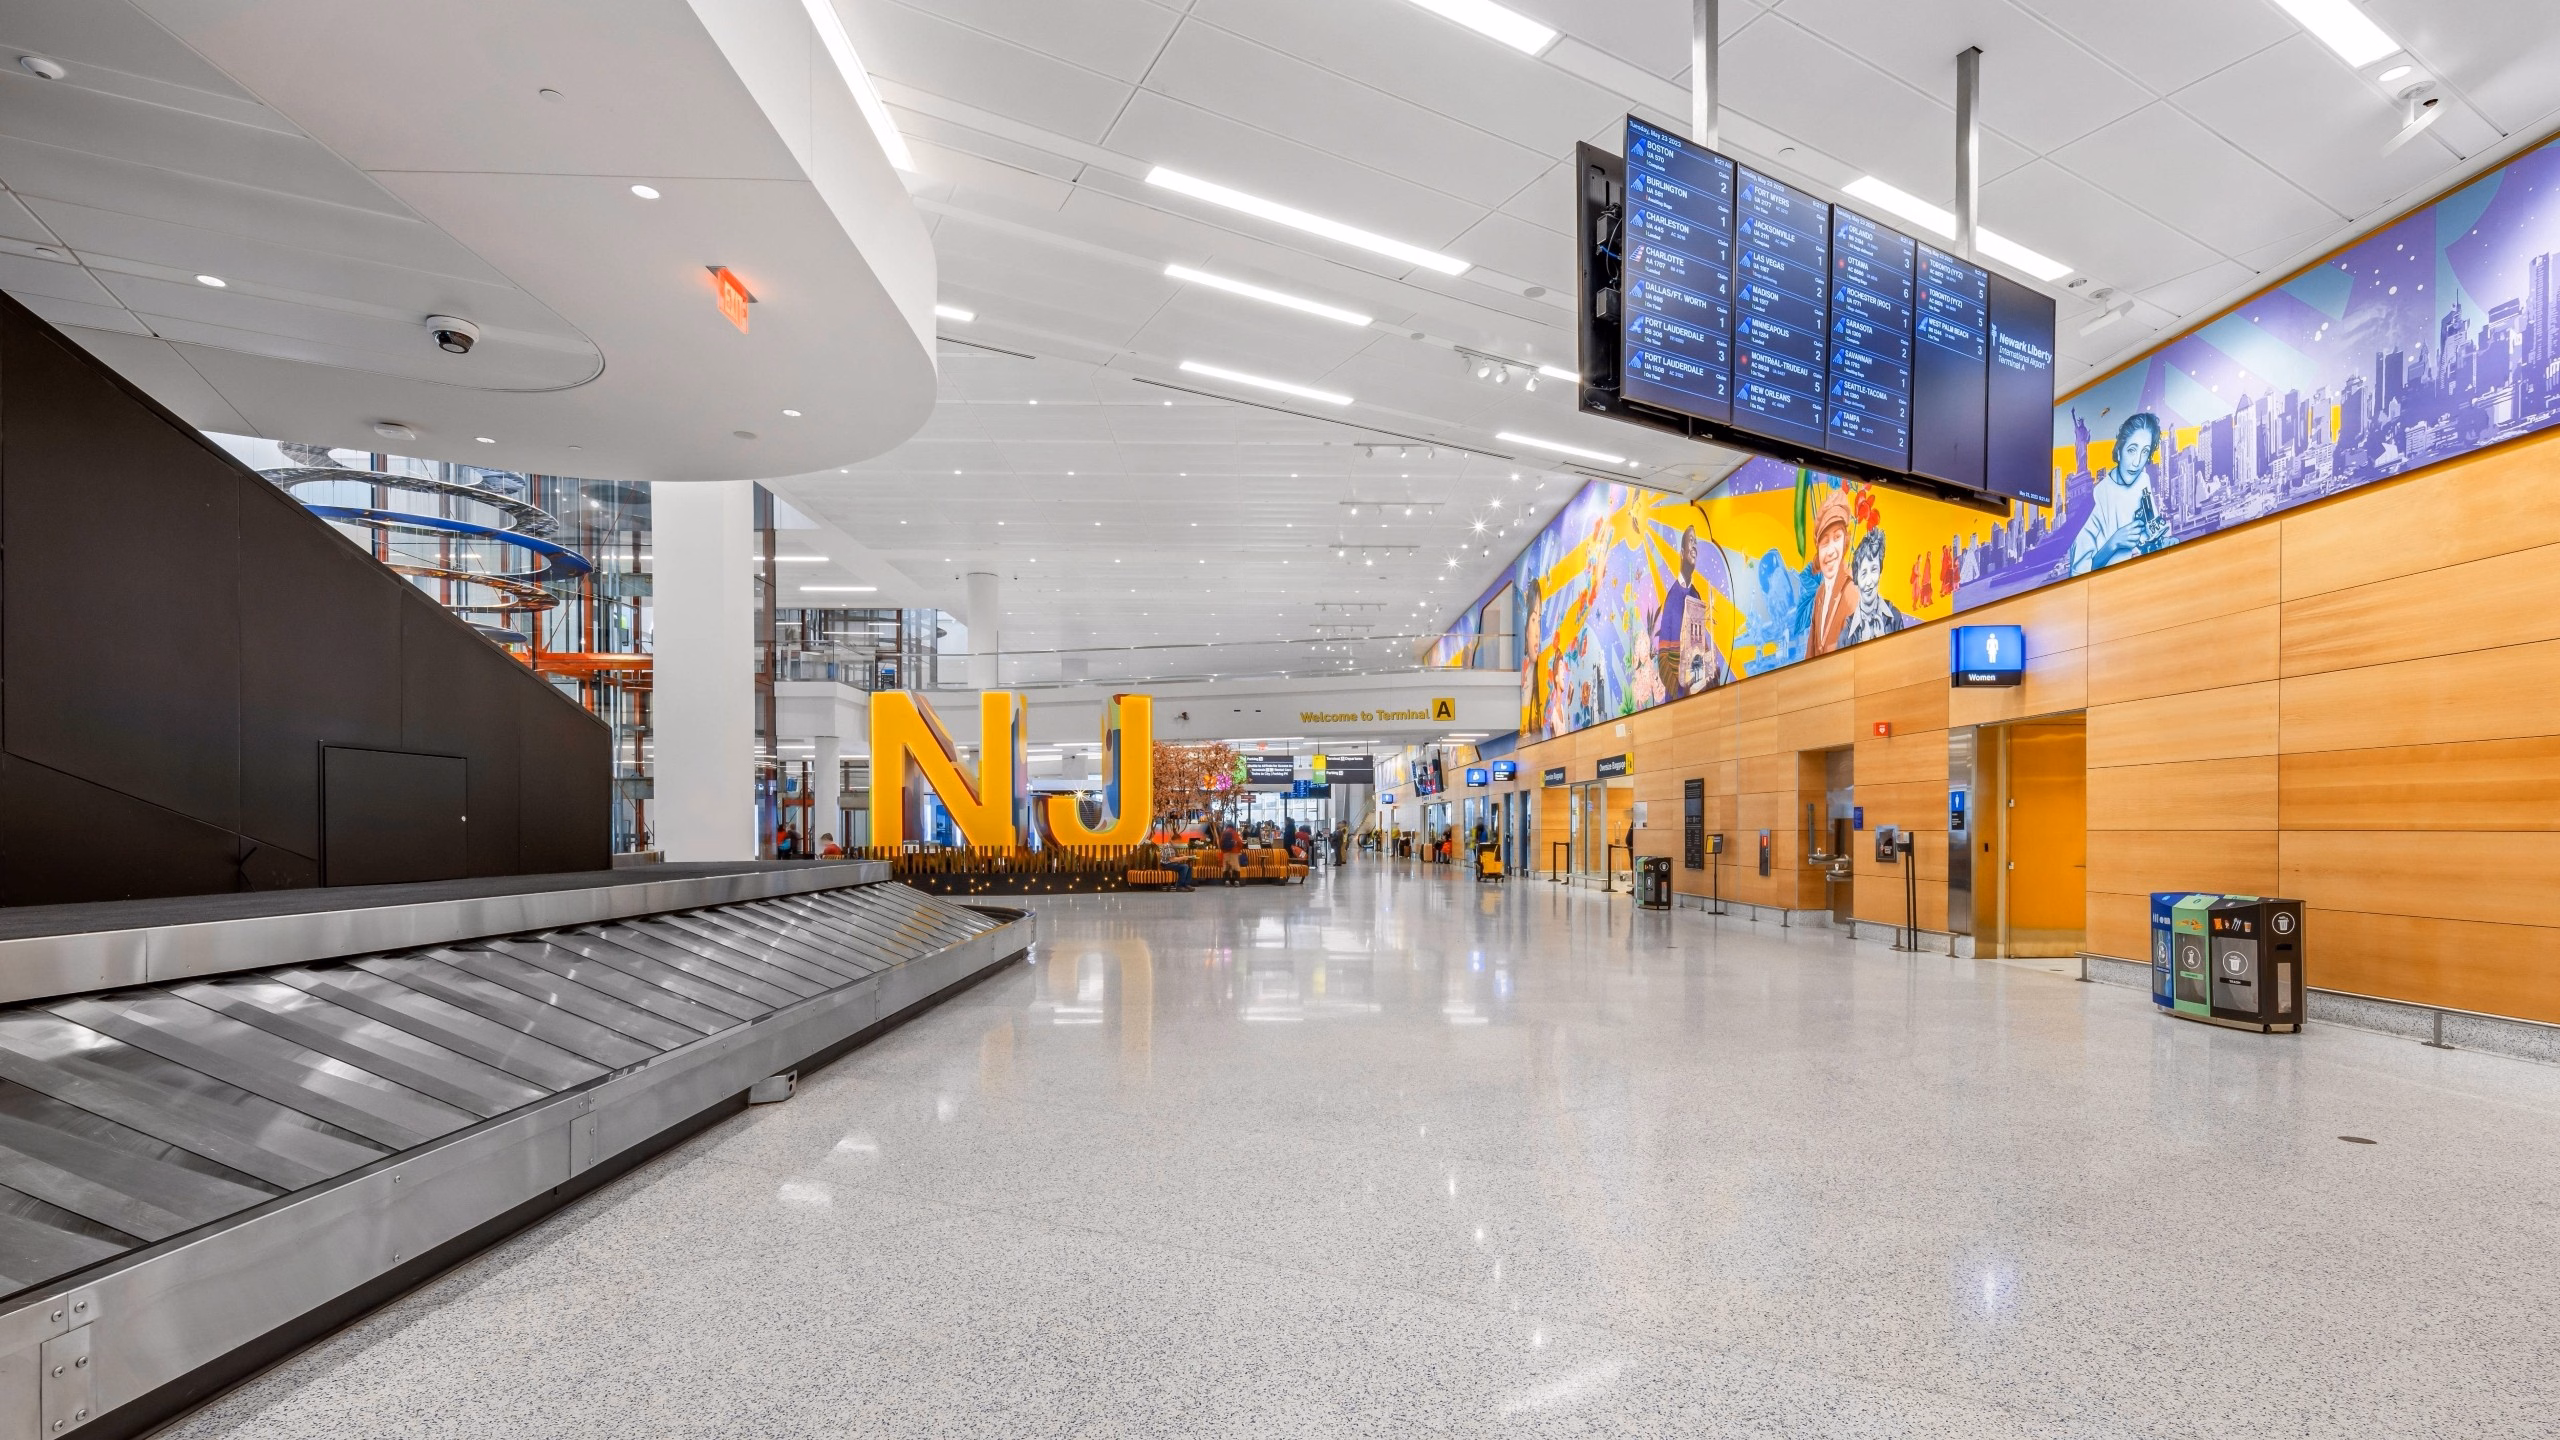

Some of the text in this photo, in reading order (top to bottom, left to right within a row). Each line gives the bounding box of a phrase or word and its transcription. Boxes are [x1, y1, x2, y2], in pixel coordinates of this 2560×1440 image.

[1629, 121, 1649, 135] Tuesday,
[1651, 130, 1660, 139] May
[1669, 138, 1681, 147] 2023
[1647, 141, 1674, 158] BOSTON
[1655, 154, 1664, 163] 570
[1647, 176, 1687, 198] BURLINGTON
[1721, 183, 1727, 193] 2
[1758, 176, 1766, 185] May
[1774, 183, 1784, 192] 2023
[1755, 186, 1789, 208] FORT MYERS
[1646, 212, 1689, 234] CHARLESTON
[1646, 222, 1664, 233] UA 445
[1754, 220, 1795, 242] JACKSONVILLE
[1754, 229, 1760, 237] UA
[1848, 225, 1873, 240] ORLANDO
[1645, 247, 1684, 266] CHARLOTTE
[1646, 258, 1665, 269] AA 1707
[1753, 253, 1784, 270] LAS VEGAS
[1848, 257, 1868, 270] OTTAWA
[1904, 258, 1909, 268] 3
[1930, 259, 1950, 273] TORONTO
[1645, 282, 1706, 308] DALLAS/FT. WORTH
[1720, 284, 1725, 294] 4
[1753, 286, 1778, 301] MADISON
[1817, 287, 1822, 298] 2
[1847, 288, 1876, 305] ROCHESTER
[1929, 288, 1950, 303] TORONTO
[1645, 317, 1662, 328] FORT
[1663, 323, 1704, 342] LAUDERDALE
[1752, 319, 1789, 337] MINNEAPOLIS
[1846, 319, 1872, 334] SARASOTA
[1929, 318, 1941, 327] WEST
[1942, 323, 1953, 333] PALM
[1954, 327, 1969, 339] BEACH
[1978, 318, 1983, 327] 5
[1719, 351, 1725, 361] 3
[1816, 351, 1821, 360] 2
[2000, 333, 2052, 364] Newark Liberty
[1645, 352, 1662, 363] FORT
[1663, 358, 1703, 376] LAUDERDALE
[1845, 350, 1872, 365] SAVANNAH
[1998, 355, 2020, 370] Terminal
[1999, 346, 2045, 369] International Airport
[1652, 365, 1664, 373] 1508
[1718, 384, 1724, 395] 2
[1751, 384, 1790, 403] NEW ORLEANS
[1815, 382, 1820, 392] 5
[1844, 381, 1887, 400] SEATTLE-TACOMA
[1843, 412, 1860, 422] TAMPA
[1900, 408, 1905, 417] 2
[1300, 701, 1451, 723] Welcome to Terminal A
[1599, 761, 1625, 771] Oversize Baggage
